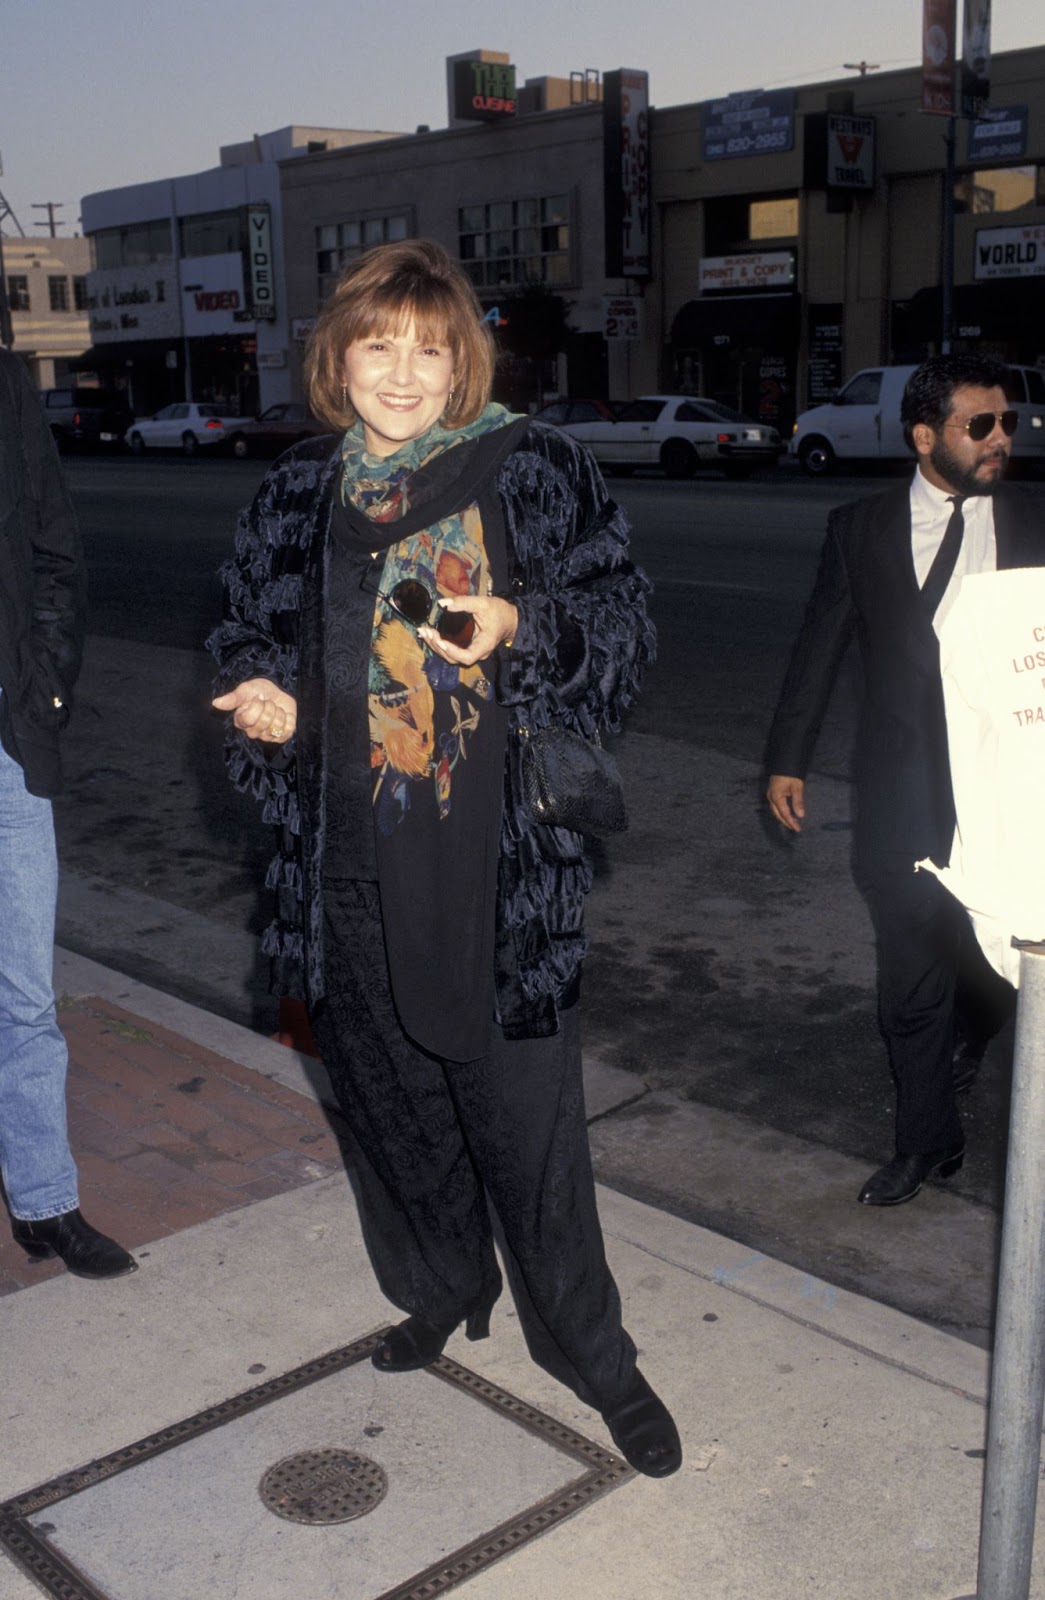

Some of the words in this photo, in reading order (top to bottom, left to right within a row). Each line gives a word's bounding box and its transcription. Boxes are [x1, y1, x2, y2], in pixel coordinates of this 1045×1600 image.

[253, 217, 270, 300] VIDEO
[979, 242, 1037, 267] WORLD
[703, 267, 734, 280] PRINT
[740, 266, 748, 277] &
[754, 263, 786, 276] COPY
[194, 290, 240, 313] VIDEO
[1012, 651, 1045, 673] LOS
